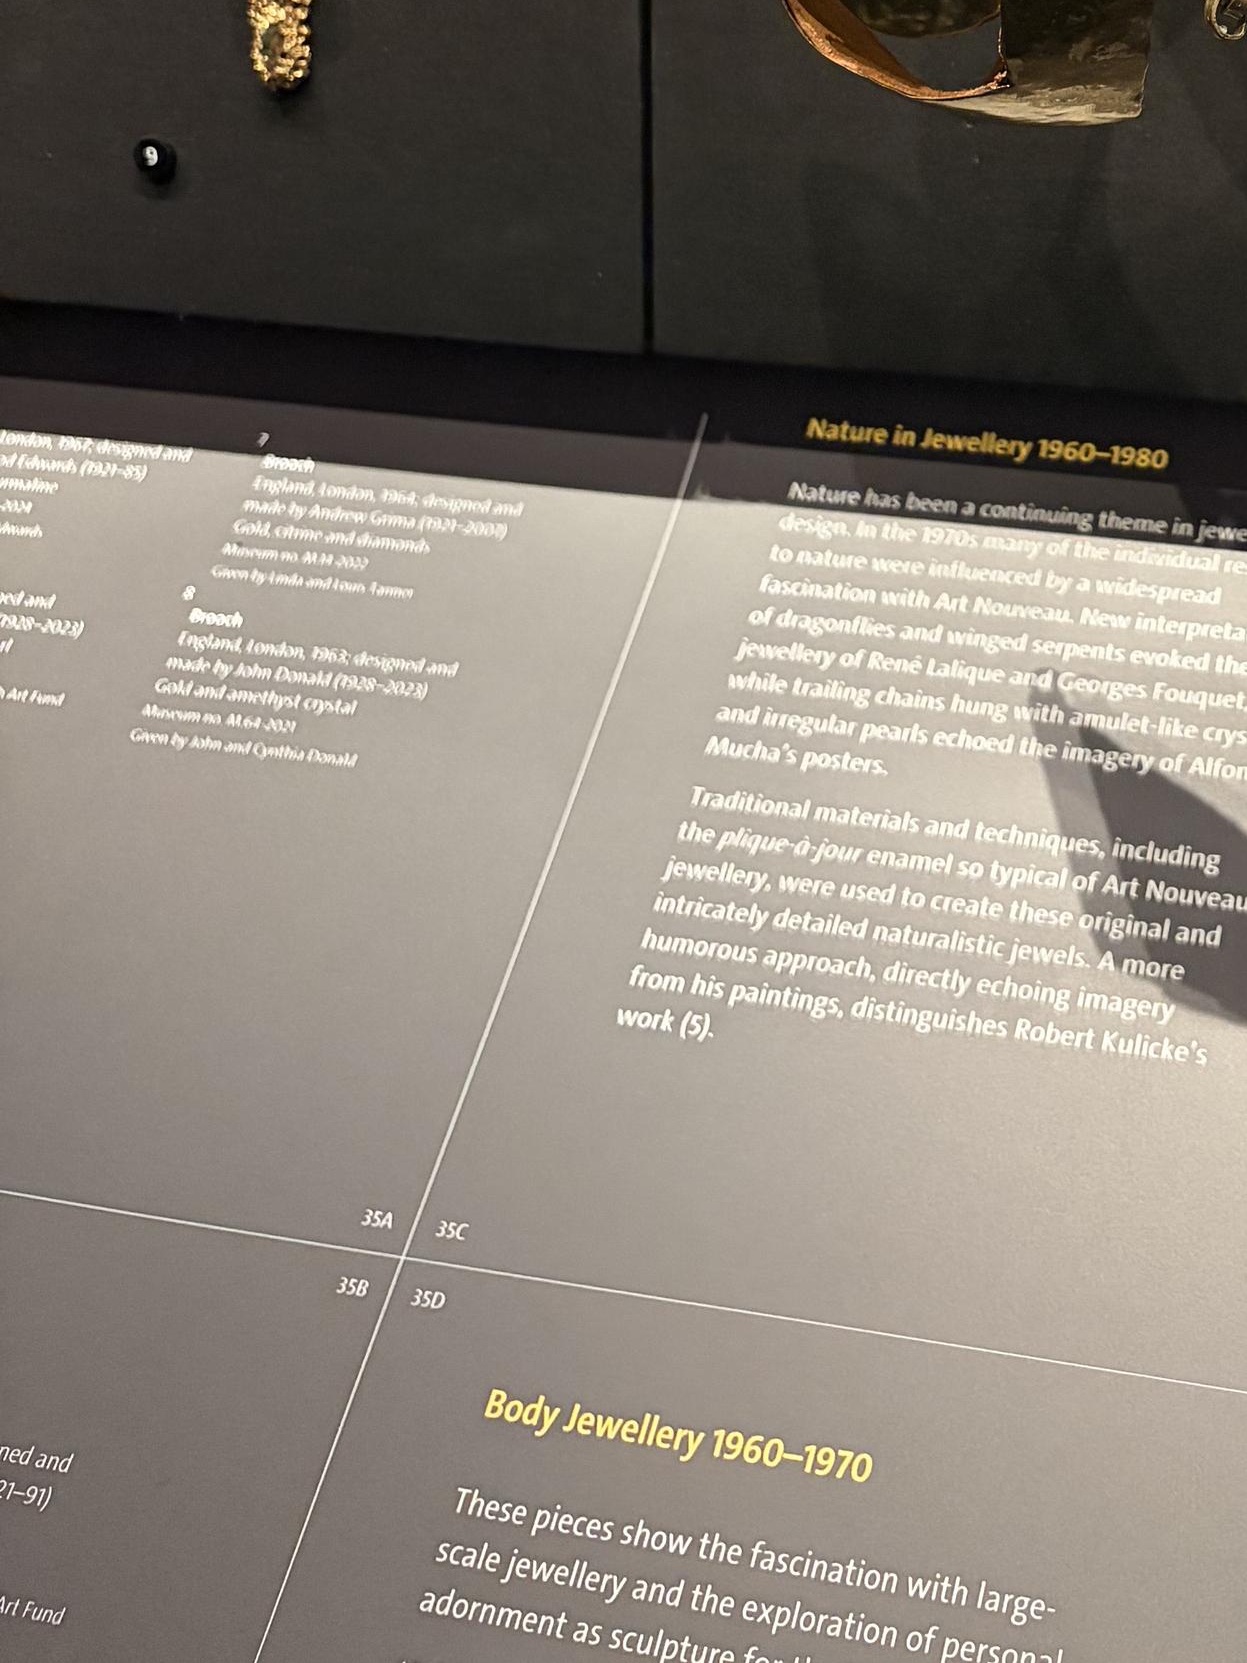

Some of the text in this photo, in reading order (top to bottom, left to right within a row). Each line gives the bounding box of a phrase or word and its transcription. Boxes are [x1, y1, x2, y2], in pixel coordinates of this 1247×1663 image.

[142, 145, 158, 167] 9
[806, 417, 888, 444] Nature
[892, 424, 916, 446] in
[919, 428, 1033, 462] Jewellery
[787, 481, 861, 506] Nature
[863, 487, 901, 509] has
[905, 491, 958, 514] been
[961, 501, 975, 516] a
[979, 502, 1094, 532] continuing
[1098, 510, 1168, 534] theme
[1171, 516, 1194, 537] in
[733, 641, 837, 671] jewellery
[838, 648, 867, 668] of
[866, 650, 923, 675] René
[925, 657, 1006, 687] Lalique
[1008, 668, 1053, 691] and
[1056, 671, 1148, 702] Georges
[691, 785, 1221, 876] Traditional materials and techniques, including
[677, 820, 716, 843] the
[866, 849, 953, 875] enamel
[957, 860, 984, 877] so
[990, 860, 1068, 888] typical
[1071, 870, 1101, 893] of
[1101, 874, 1141, 899] Art
[617, 1008, 714, 1042] work (5).
[628, 965, 685, 994] from
[689, 972, 725, 999] his
[727, 984, 843, 1019] paintings,
[850, 995, 1008, 1037] distinguishes
[1014, 1017, 1095, 1049] Robert
[360, 1208, 393, 1229] 35A
[435, 1220, 469, 1240] 35C
[336, 1276, 369, 1297] 35B
[410, 1288, 446, 1309] 35D
[484, 1388, 561, 1437] Body
[561, 1403, 706, 1462] Jewellery
[34, 1453, 74, 1473] and
[455, 1487, 1056, 1626] These pieces show the fascination with large-
[22, 1600, 66, 1625] Fund
[435, 1541, 501, 1572] scale
[499, 1548, 627, 1604] jewellery
[631, 1579, 685, 1607] and
[691, 1584, 735, 1616] the
[742, 1600, 897, 1648] exploration
[906, 1625, 939, 1654] of
[419, 1588, 568, 1639] adornment
[572, 1621, 603, 1646] as
[608, 1628, 736, 1663] sculpture
